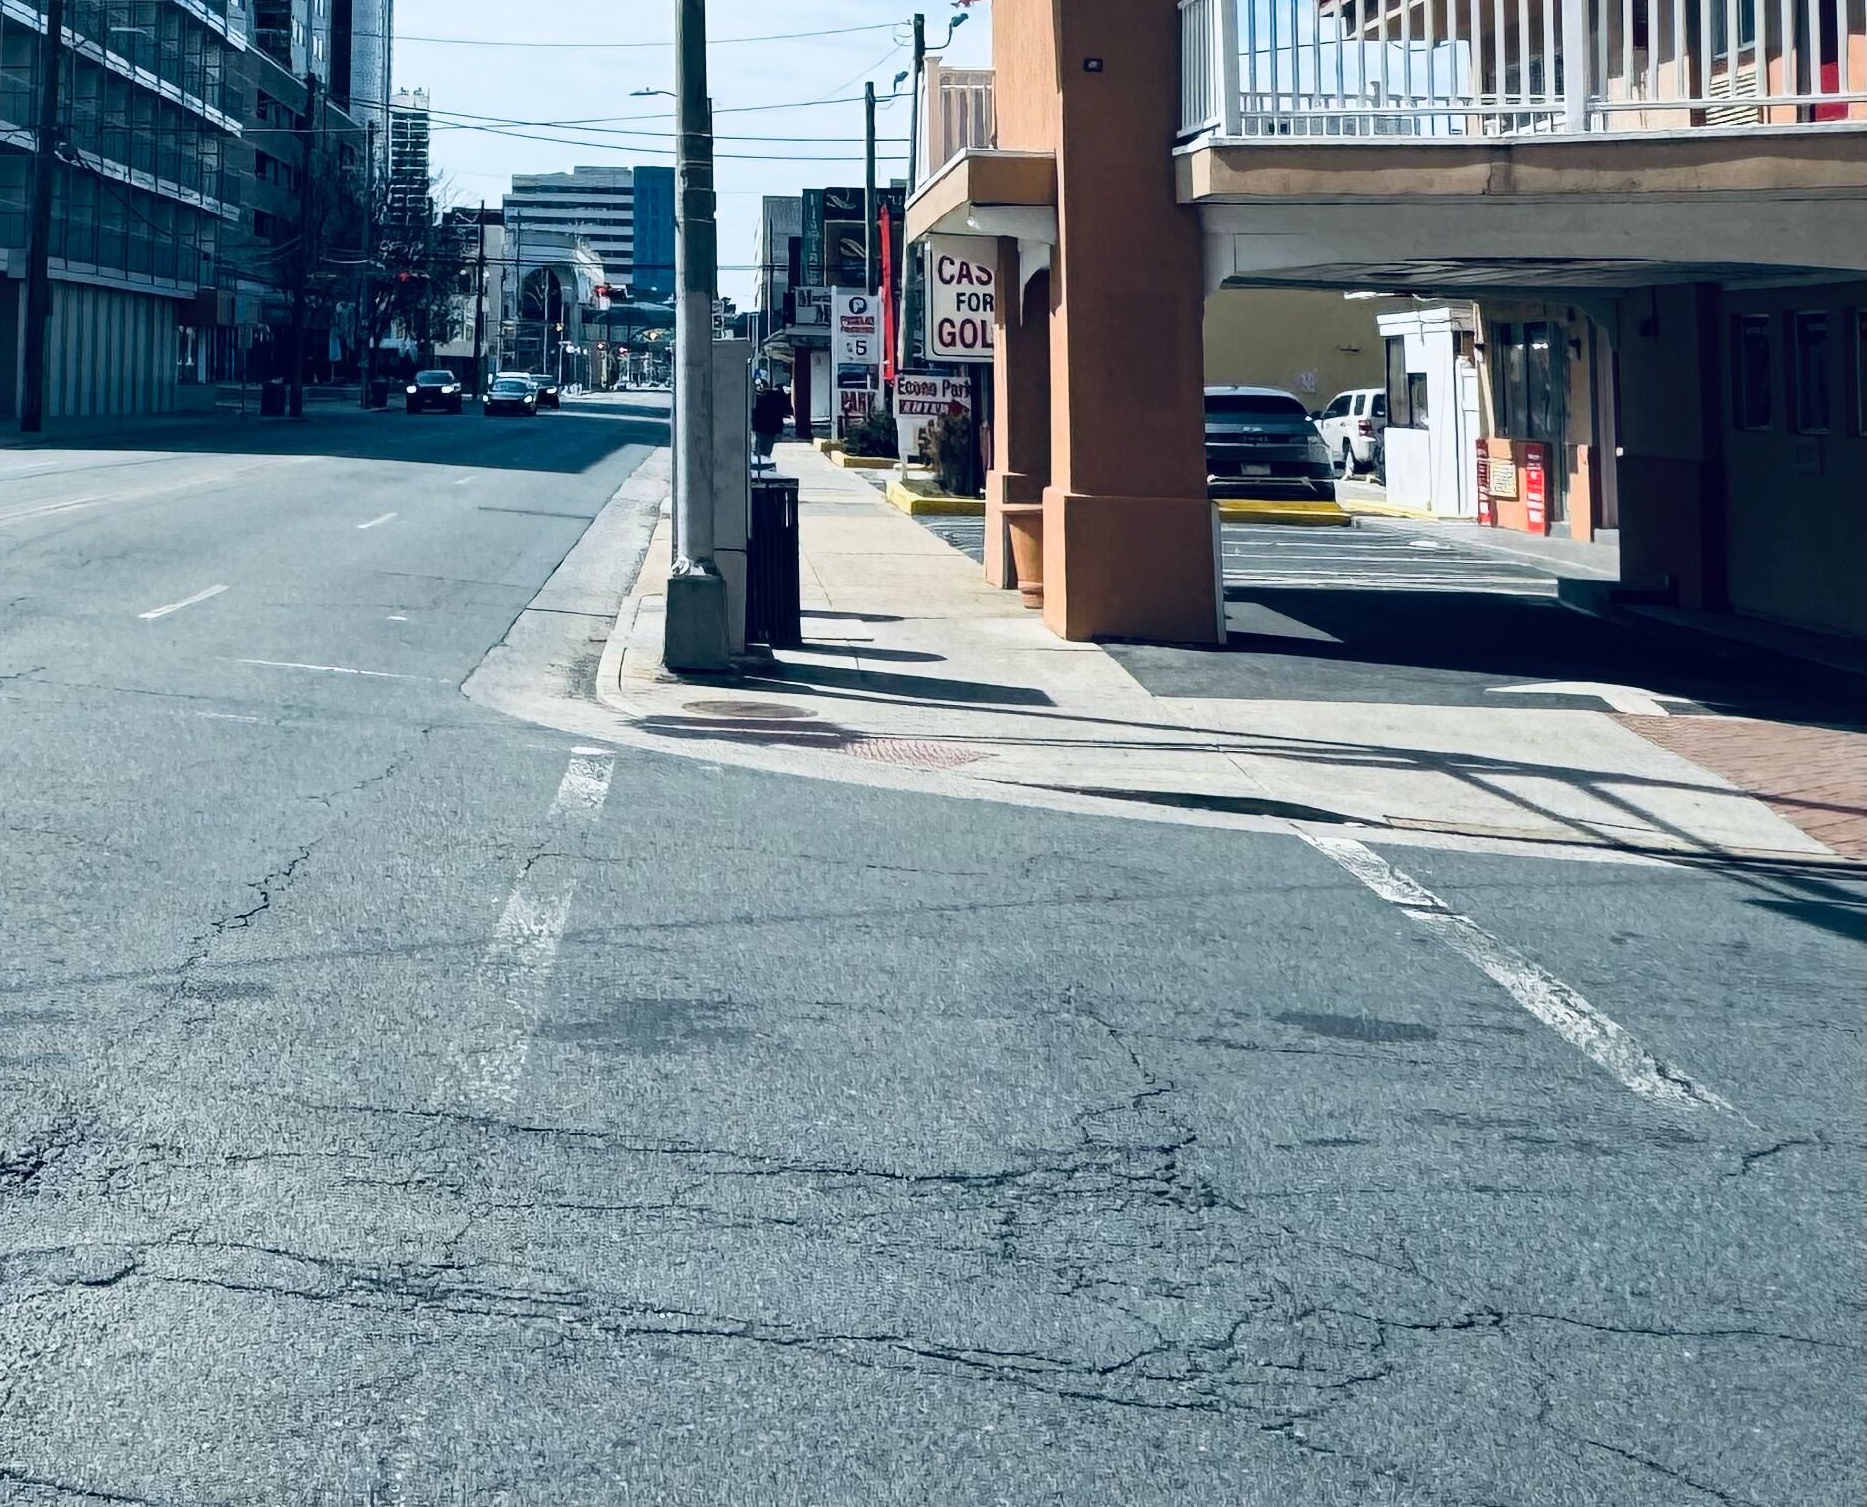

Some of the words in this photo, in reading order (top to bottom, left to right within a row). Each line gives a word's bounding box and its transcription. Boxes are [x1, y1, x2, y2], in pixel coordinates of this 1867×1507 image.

[937, 254, 994, 286] CAS
[955, 292, 994, 313] FOR
[937, 317, 994, 350] GOL
